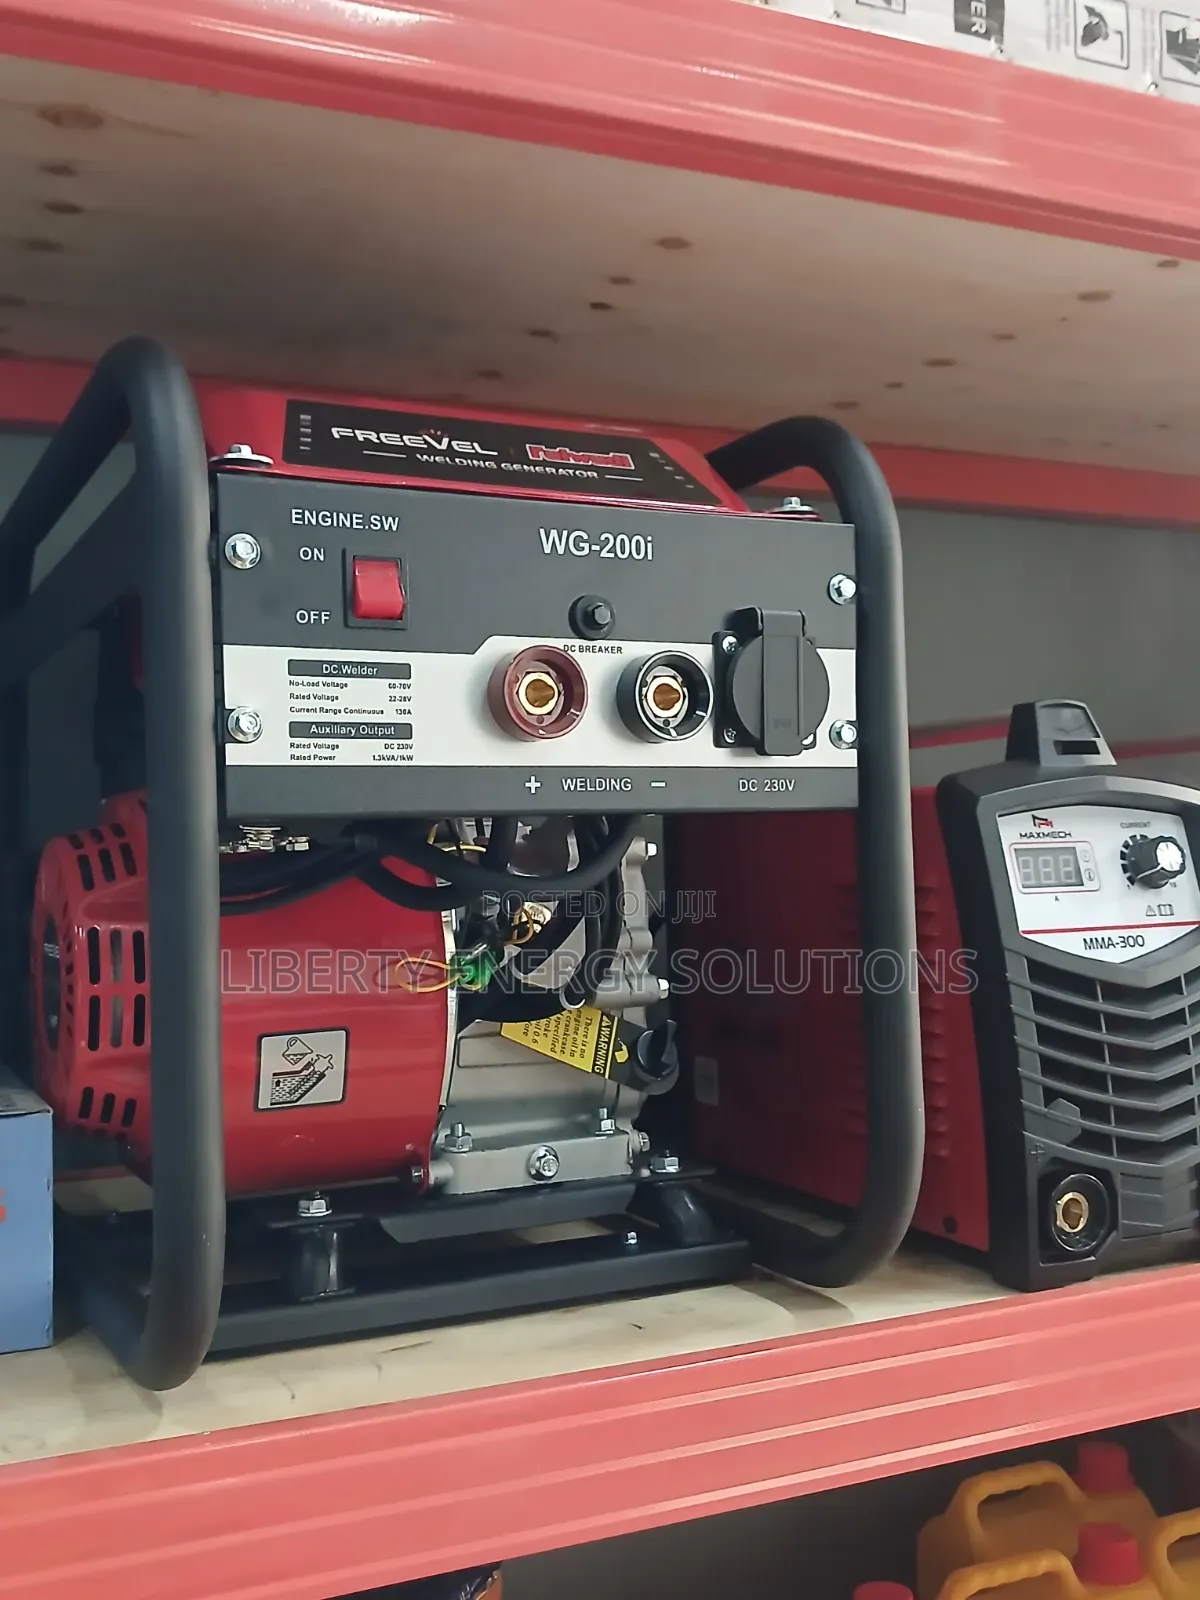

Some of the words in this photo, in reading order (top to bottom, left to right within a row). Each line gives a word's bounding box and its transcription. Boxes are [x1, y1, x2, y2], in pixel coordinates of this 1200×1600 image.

[331, 427, 498, 456] FREEVEL
[416, 453, 498, 469] WELDING
[500, 462, 599, 480] GENERATOR
[291, 508, 399, 532] ENGINE.SW
[539, 527, 653, 561] WG-200i
[299, 546, 325, 561] ON
[296, 609, 331, 625] OFF
[563, 644, 578, 654] DC
[579, 644, 623, 655] BREAKER
[289, 680, 320, 688] No-Load
[321, 680, 348, 690] Voltage
[289, 692, 311, 700] Rated
[312, 693, 339, 702] Voltage
[388, 695, 412, 703] 22-28V
[289, 706, 318, 714] Current
[318, 706, 342, 716] Range
[343, 707, 384, 715] Continuous
[395, 708, 412, 716] 130A
[310, 724, 357, 737] Auxiliary
[359, 725, 395, 737] Output
[312, 742, 340, 751] Voltage
[561, 777, 632, 792] WELDING
[739, 779, 758, 792] DC
[763, 779, 795, 792] 230V
[1019, 830, 1072, 839] MAXMECH
[1082, 934, 1145, 951] MMA-300
[573, 1009, 584, 1036] engine
[582, 1016, 593, 1039] There
[549, 1016, 562, 1054] specified
[571, 1036, 579, 1048] oil
[581, 1039, 590, 1048] is
[569, 1049, 577, 1058] in
[579, 1048, 587, 1059] no
[594, 1026, 611, 1074] WARNING
